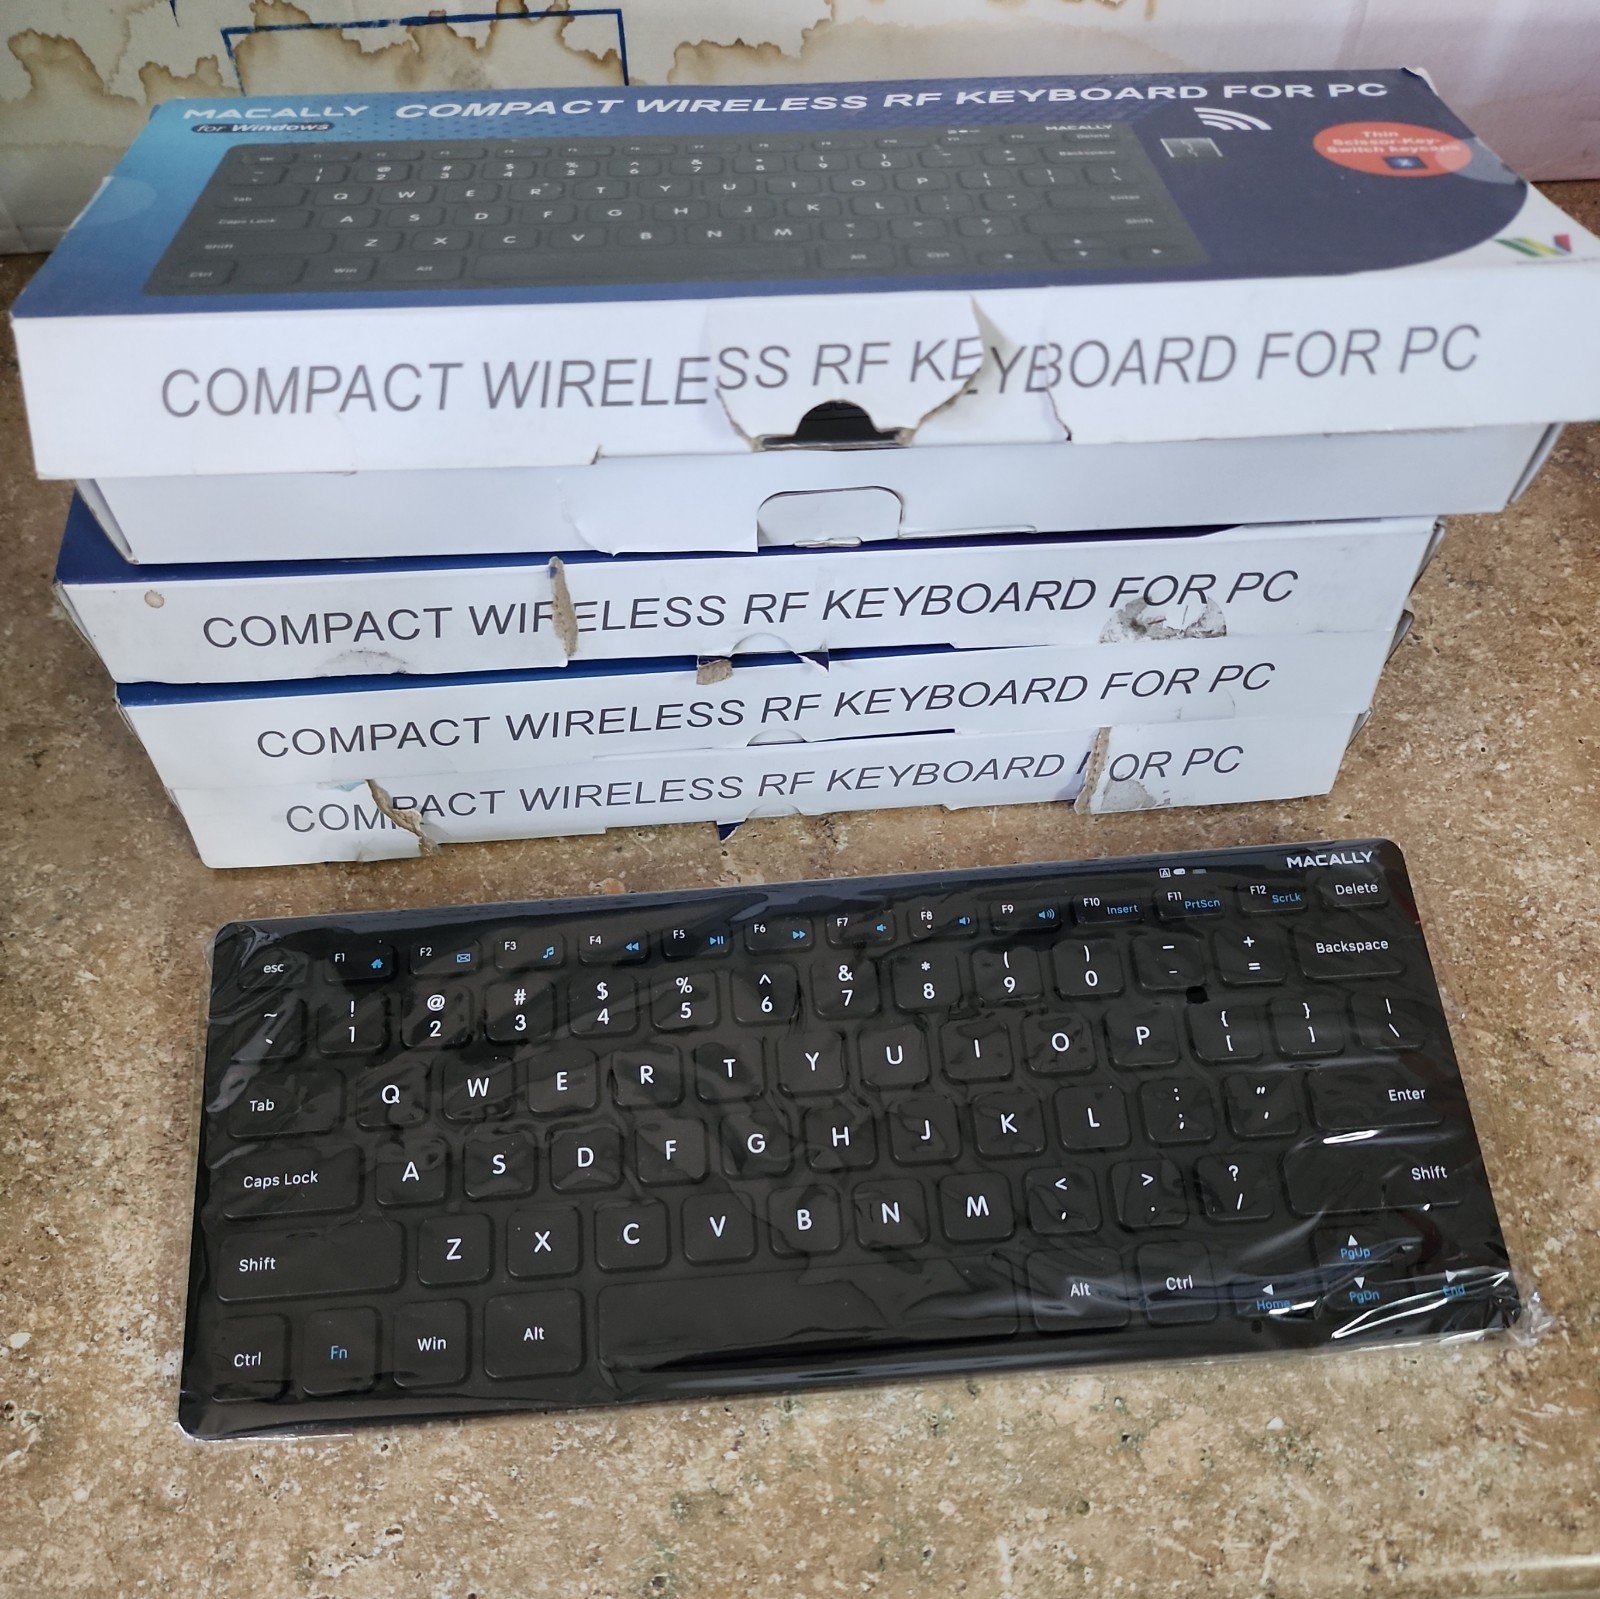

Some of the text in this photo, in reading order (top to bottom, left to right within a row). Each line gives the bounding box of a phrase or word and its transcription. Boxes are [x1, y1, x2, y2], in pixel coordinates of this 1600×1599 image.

[182, 83, 1387, 120] MACALLY COMPACT WIRELESS RF KEYBOARD FOR PC
[231, 122, 329, 132] Windows
[162, 324, 1480, 418] COMPACT WIRELESS RF KEYBOARD FOR PC
[203, 607, 452, 648] COMPACT
[744, 592, 810, 624] RF
[822, 579, 1096, 620] KEYBOARD
[1109, 574, 1216, 610] FOR
[1226, 570, 1298, 604] PC
[257, 662, 1276, 758] COMPACT WIRELESS RF KEYBOARD FOR PC
[519, 776, 743, 812] WIRELESS
[758, 771, 815, 797] RF
[826, 754, 1065, 792] KEYBOARD
[1182, 746, 1244, 776] PC
[1286, 850, 1372, 868] MACALLY
[1167, 891, 1182, 901] F11
[1250, 885, 1266, 895] F12
[1335, 883, 1378, 895] Delete
[1083, 897, 1100, 907] F10
[1184, 899, 1220, 909] PrtScn
[1272, 892, 1302, 903] ScrLk
[920, 911, 932, 920] F8
[1002, 904, 1014, 914] F9
[1107, 904, 1138, 914] Insert
[754, 924, 766, 933] F6
[837, 917, 848, 927] F7
[590, 936, 602, 945] F4
[673, 929, 685, 939] F5
[420, 947, 432, 956] F2
[504, 941, 516, 950] F3
[1316, 940, 1388, 954] Backspace
[334, 953, 345, 962] F1
[263, 964, 284, 974] esc
[924, 983, 935, 999] 8
[1004, 976, 1016, 993] 9
[761, 996, 773, 1012] 6
[842, 990, 853, 1006] 7
[597, 1008, 610, 1024] 4
[680, 1002, 692, 1018] 5
[430, 1020, 441, 1037] 2
[514, 1014, 526, 1031] 3
[1136, 1026, 1150, 1045] P
[805, 1052, 819, 1071] Y
[886, 1045, 903, 1064] U
[640, 1065, 654, 1084] R
[723, 1058, 736, 1078] T
[467, 1078, 489, 1098] W
[557, 1072, 568, 1091] E
[382, 1084, 400, 1104] Q
[1388, 1089, 1425, 1101] Enter
[250, 1098, 274, 1112] Tab
[1000, 1113, 1018, 1134] K
[1088, 1108, 1100, 1128] L
[832, 1126, 850, 1147] H
[921, 1120, 930, 1140] J
[666, 1140, 676, 1160] F
[747, 1134, 766, 1153] G
[492, 1154, 506, 1174] S
[578, 1147, 594, 1167] D
[402, 1161, 419, 1182] A
[1411, 1166, 1448, 1180] Shift
[244, 1170, 318, 1190] Caps Lock
[882, 1202, 900, 1224] N
[967, 1196, 989, 1218] M
[710, 1216, 726, 1237] V
[797, 1209, 812, 1230] B
[534, 1230, 552, 1253] X
[623, 1223, 640, 1244] C
[446, 1238, 462, 1260] Z
[1340, 1248, 1370, 1260] PgUp
[239, 1257, 276, 1272] Shift
[1070, 1282, 1091, 1297] Alt
[1166, 1275, 1193, 1290] Ctrl
[1442, 1283, 1465, 1296] End
[1349, 1289, 1380, 1303] PgDn
[524, 1326, 544, 1341] Alt
[417, 1336, 446, 1351] Win
[234, 1352, 261, 1367] Ctrl
[331, 1345, 348, 1360] Fn
